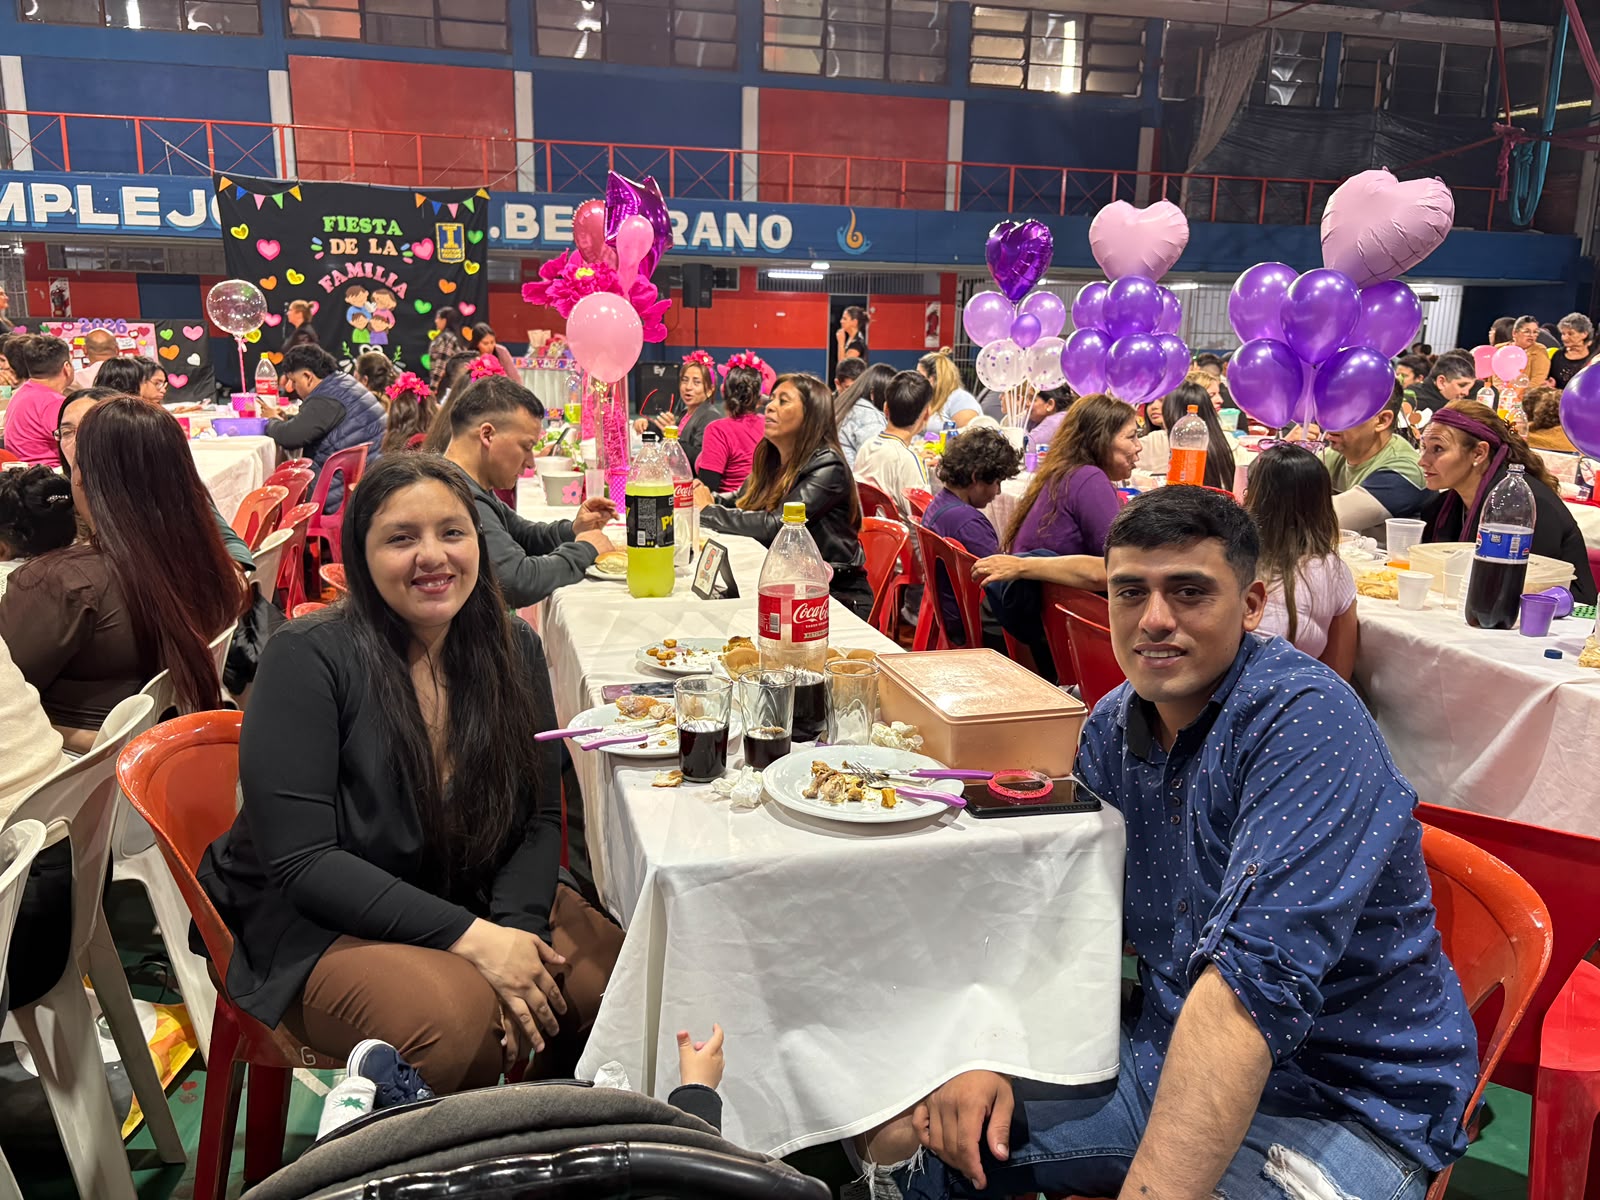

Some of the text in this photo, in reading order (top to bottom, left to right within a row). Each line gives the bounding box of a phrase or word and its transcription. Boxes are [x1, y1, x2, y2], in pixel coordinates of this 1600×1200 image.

[0, 182, 222, 227] MPLEJ
[322, 215, 403, 236] FIESTA
[329, 238, 398, 256] DE LA
[318, 261, 408, 299] FAMILIA
[78, 318, 128, 334] 2026
